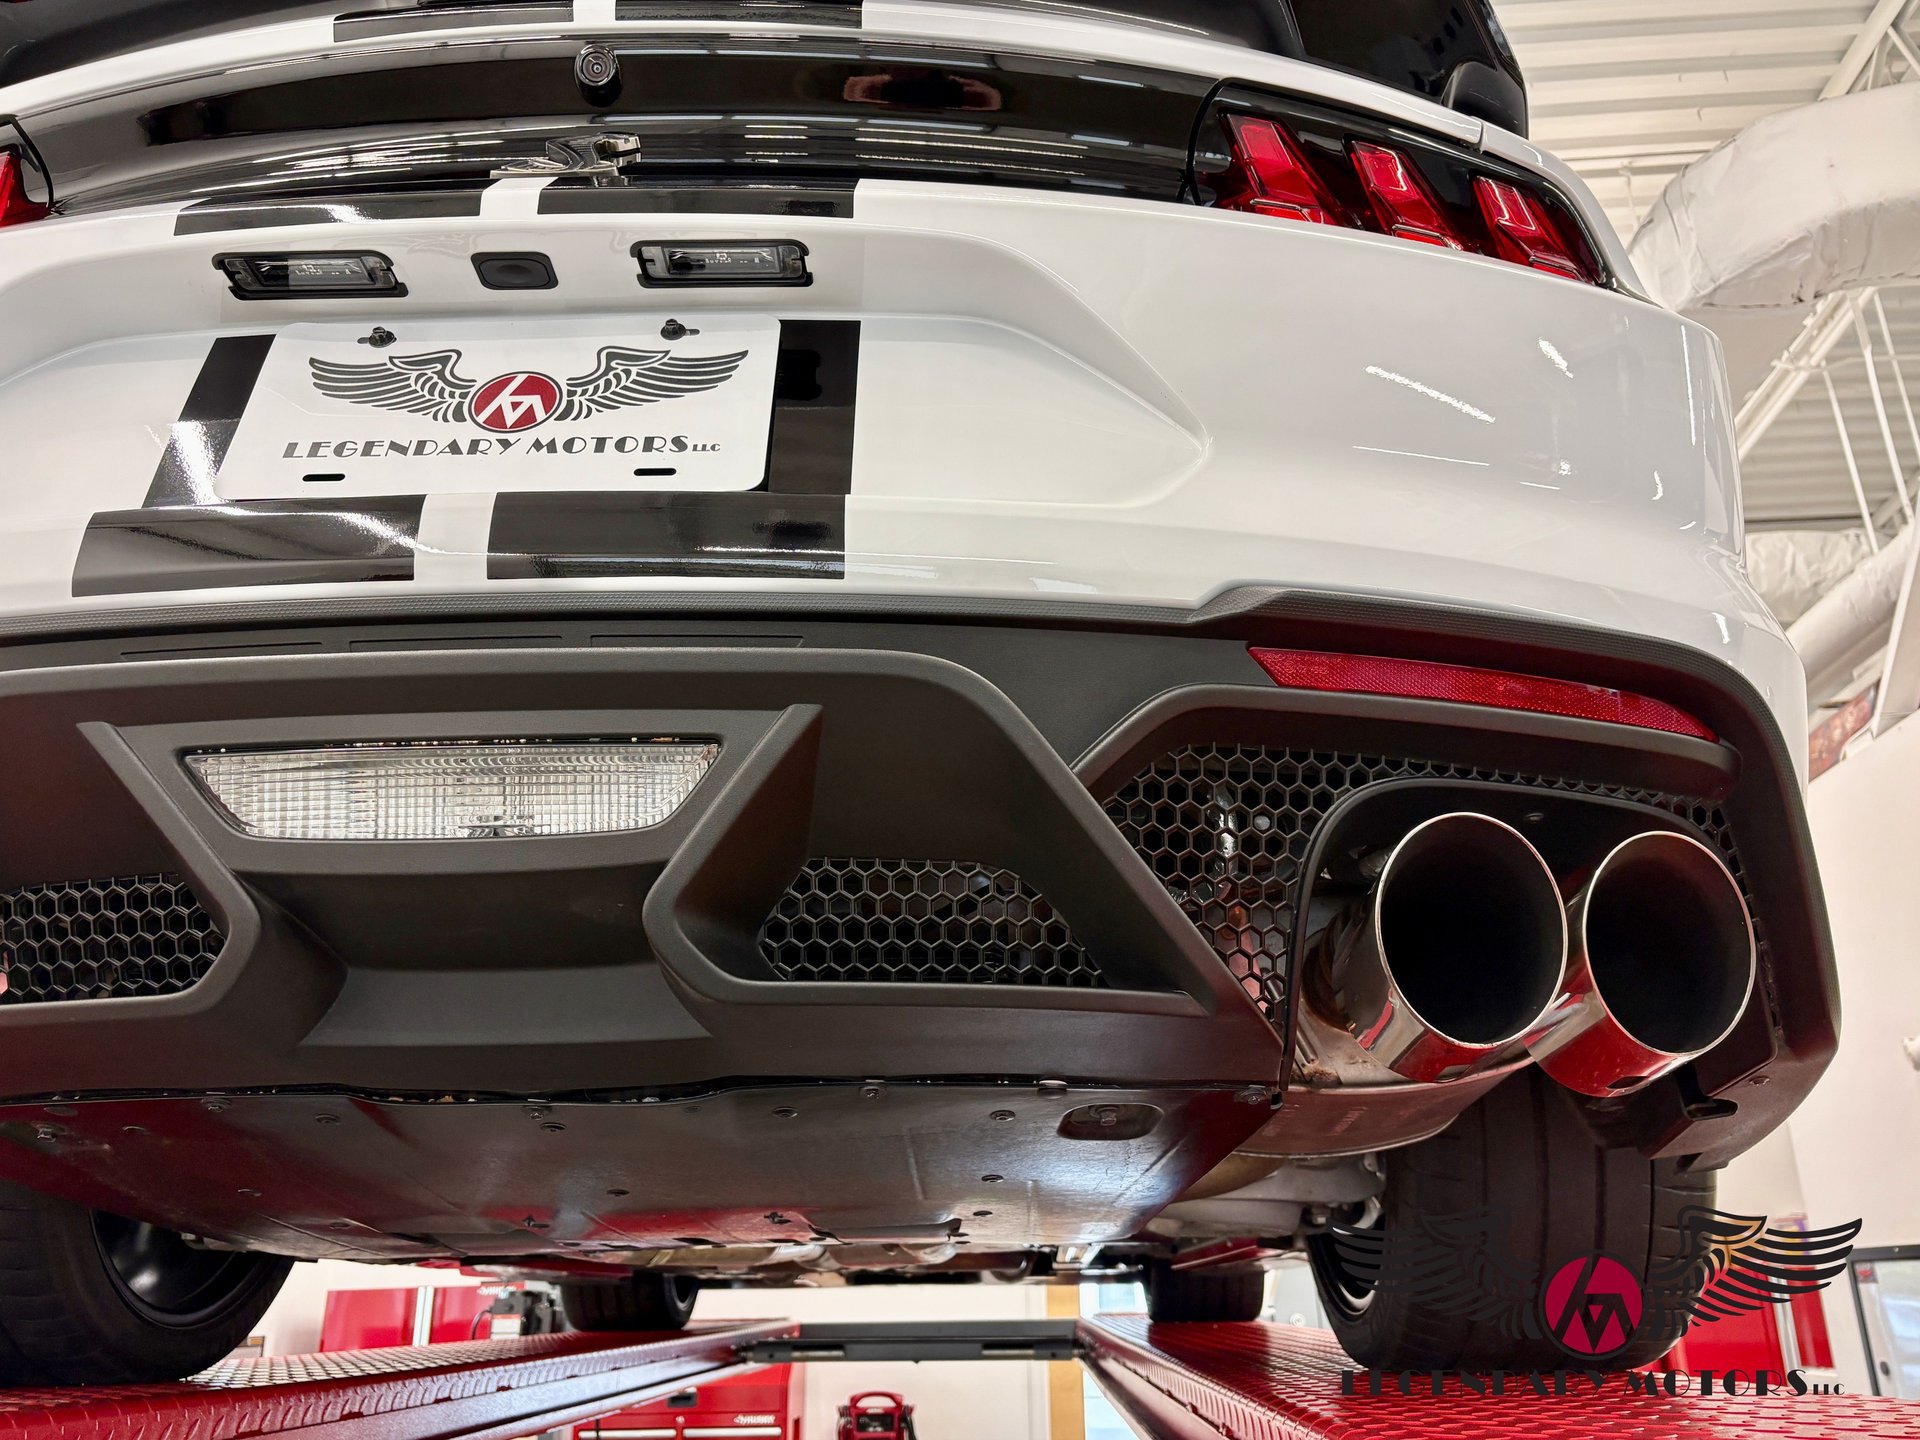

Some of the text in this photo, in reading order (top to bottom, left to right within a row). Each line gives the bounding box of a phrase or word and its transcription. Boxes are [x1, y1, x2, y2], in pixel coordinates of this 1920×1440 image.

[282, 435, 721, 459] LEGENDARY MOTORS LLC
